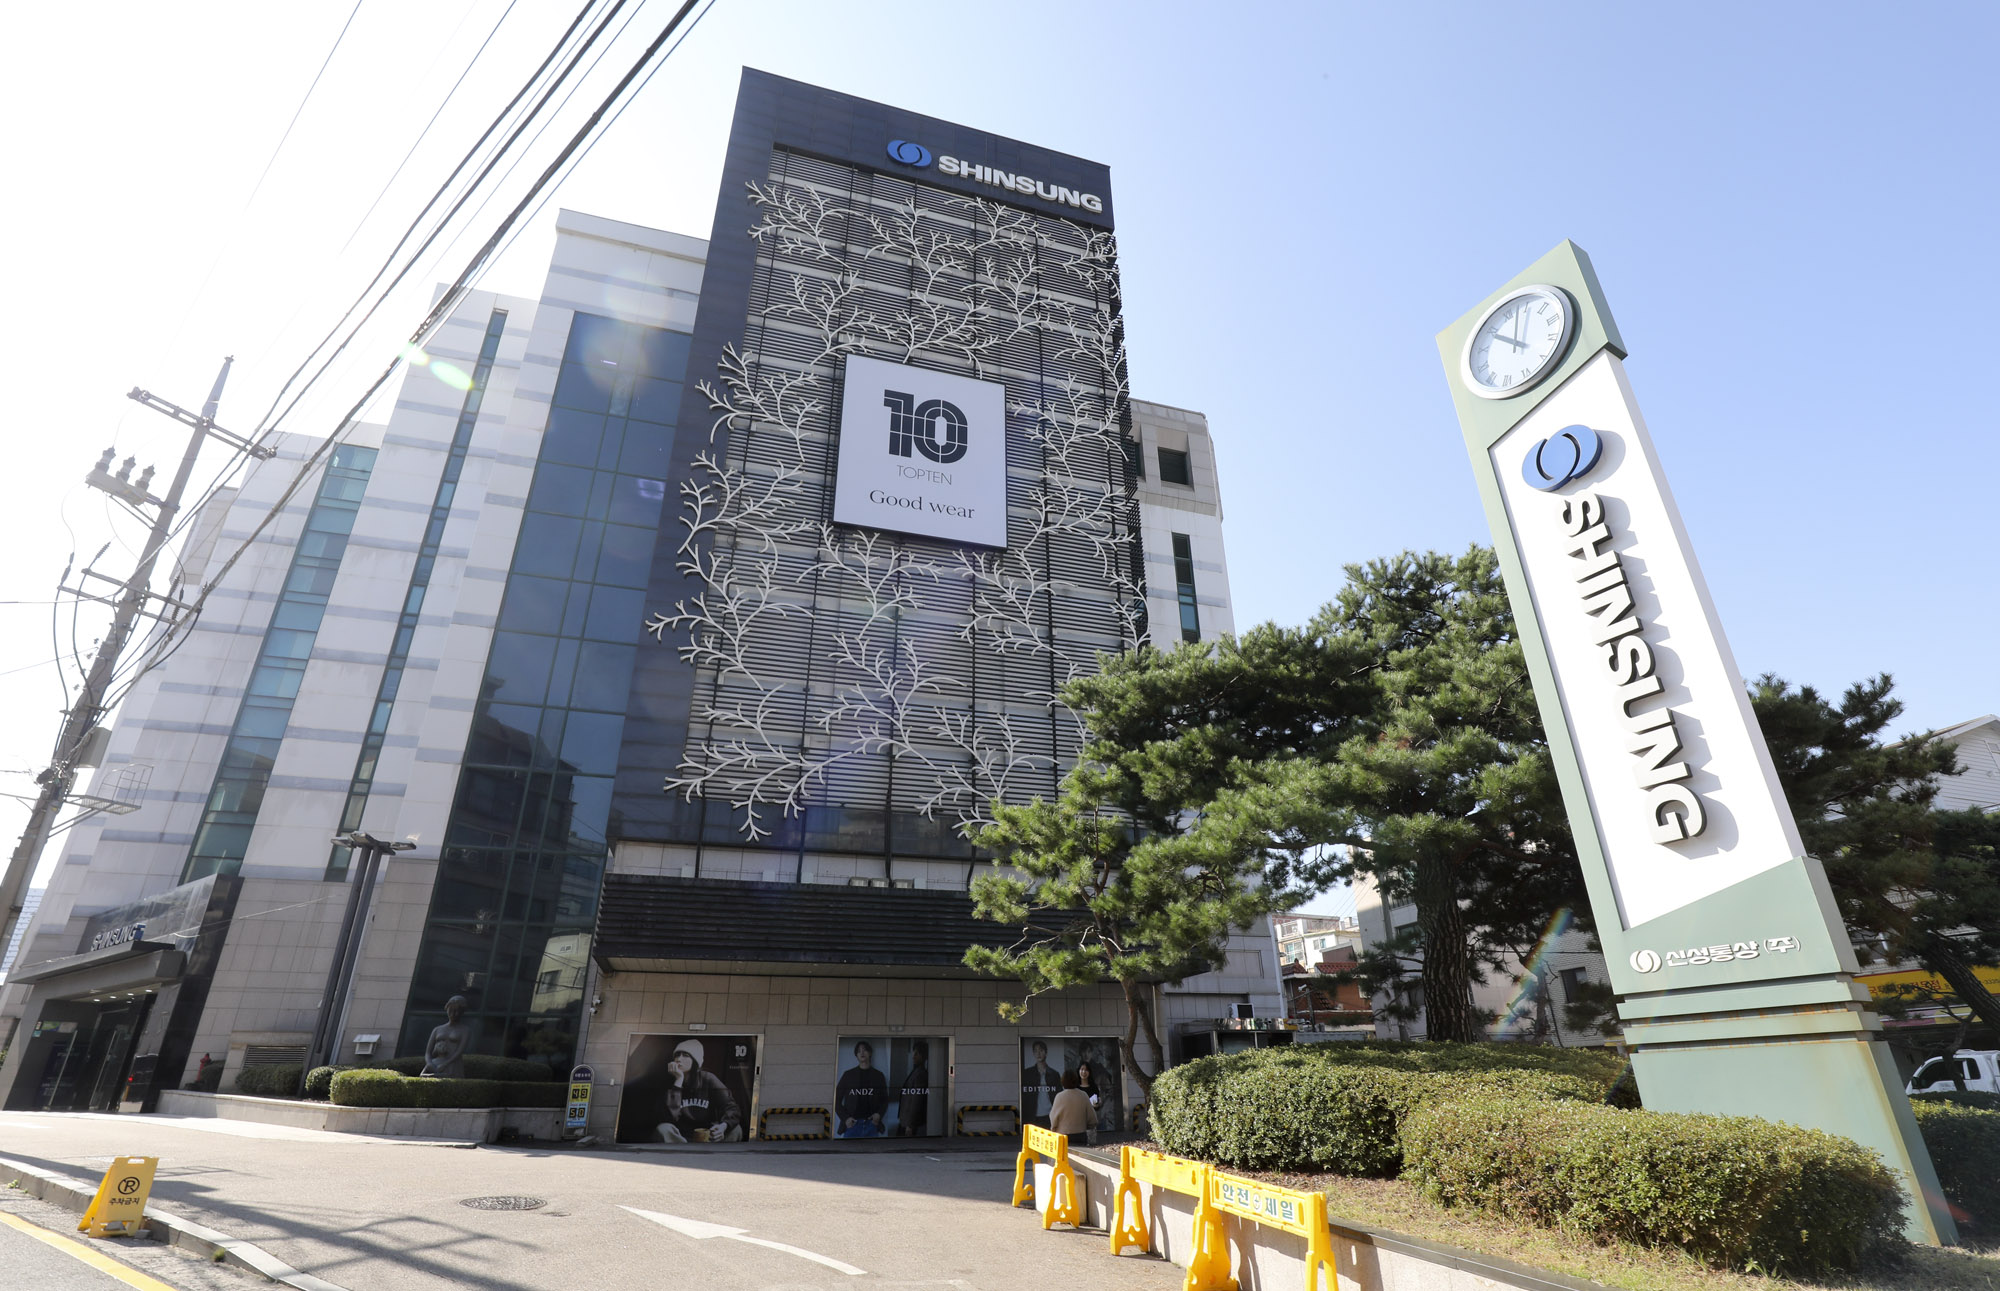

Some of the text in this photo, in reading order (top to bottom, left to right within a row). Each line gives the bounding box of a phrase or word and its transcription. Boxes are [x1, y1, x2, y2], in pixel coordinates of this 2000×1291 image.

[938, 155, 1103, 213] SHINSUNG
[883, 389, 969, 464] 10
[896, 465, 953, 485] TOPTEN
[869, 489, 976, 519] Good wear
[1559, 493, 1707, 845] SHINSUNG
[1665, 935, 1801, 967] 신성통상 (주)
[735, 1045, 747, 1057] 10
[849, 1088, 875, 1096] ANDZ
[109, 1197, 140, 1205] 주차금지
[1222, 1183, 1294, 1220] 안전 제일
